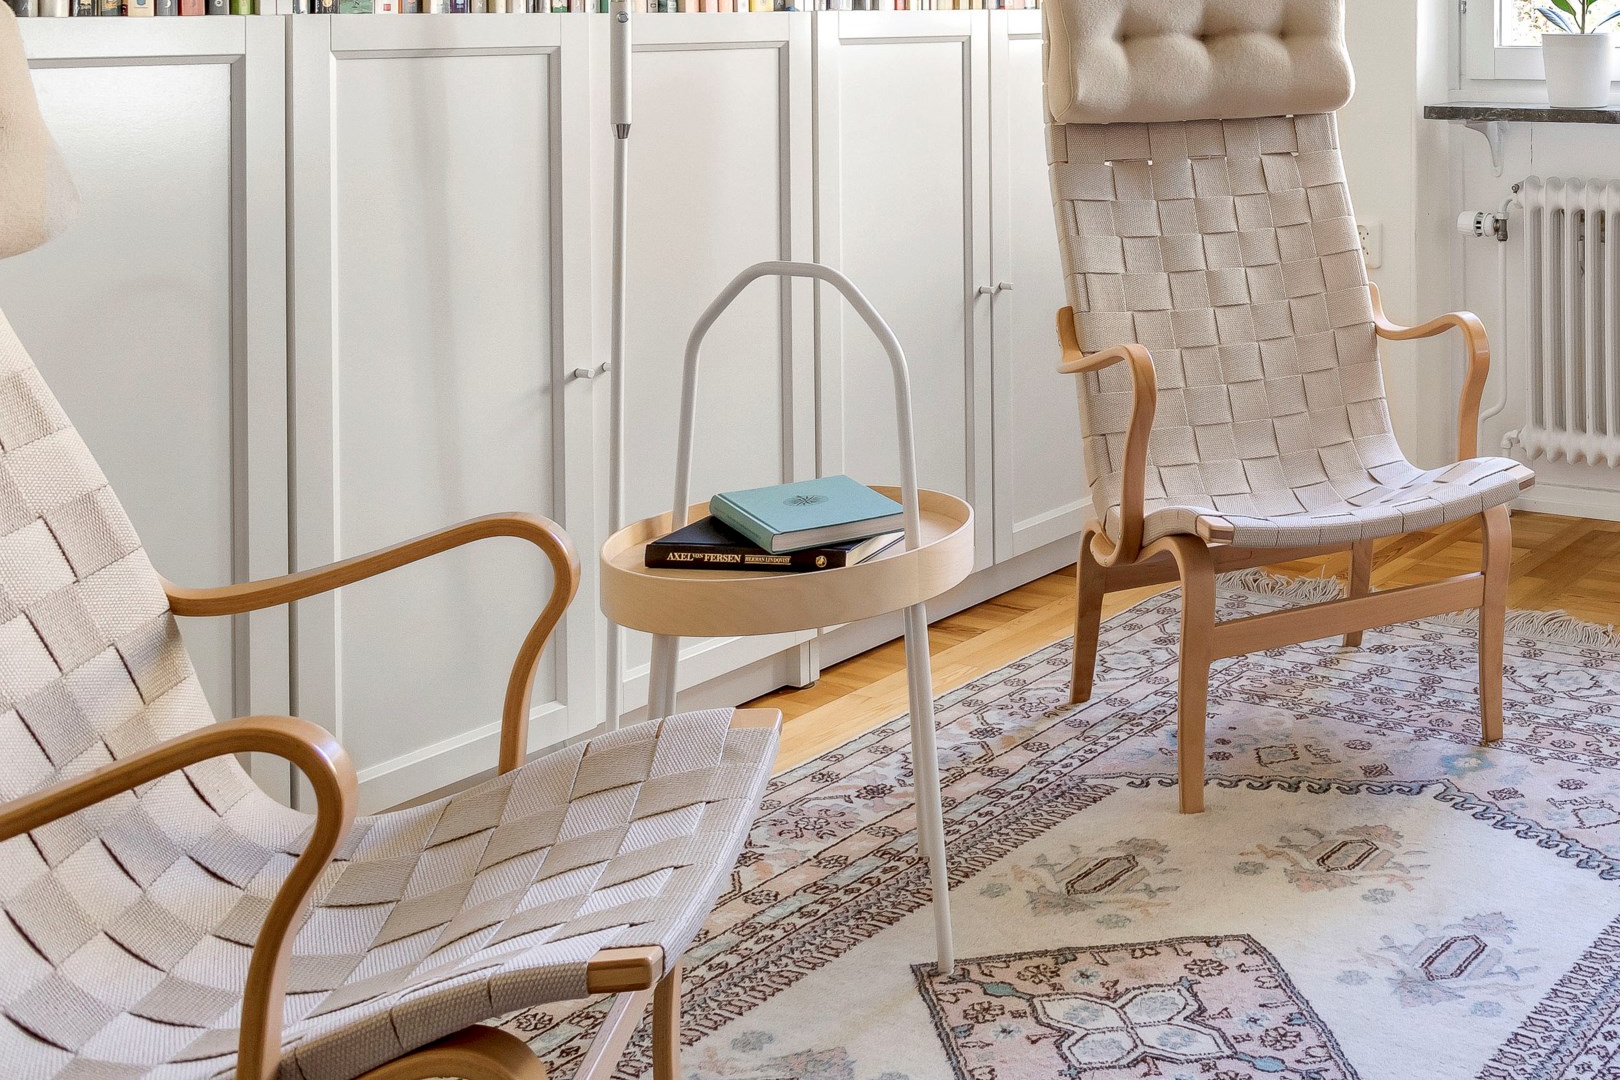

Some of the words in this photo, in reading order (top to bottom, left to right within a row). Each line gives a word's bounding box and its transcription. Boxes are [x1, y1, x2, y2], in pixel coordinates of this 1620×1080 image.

[667, 552, 693, 562] AXEL
[704, 553, 741, 563] FERSEN
[745, 555, 764, 563] HERMAN
[764, 556, 791, 565] LINDQVIST
